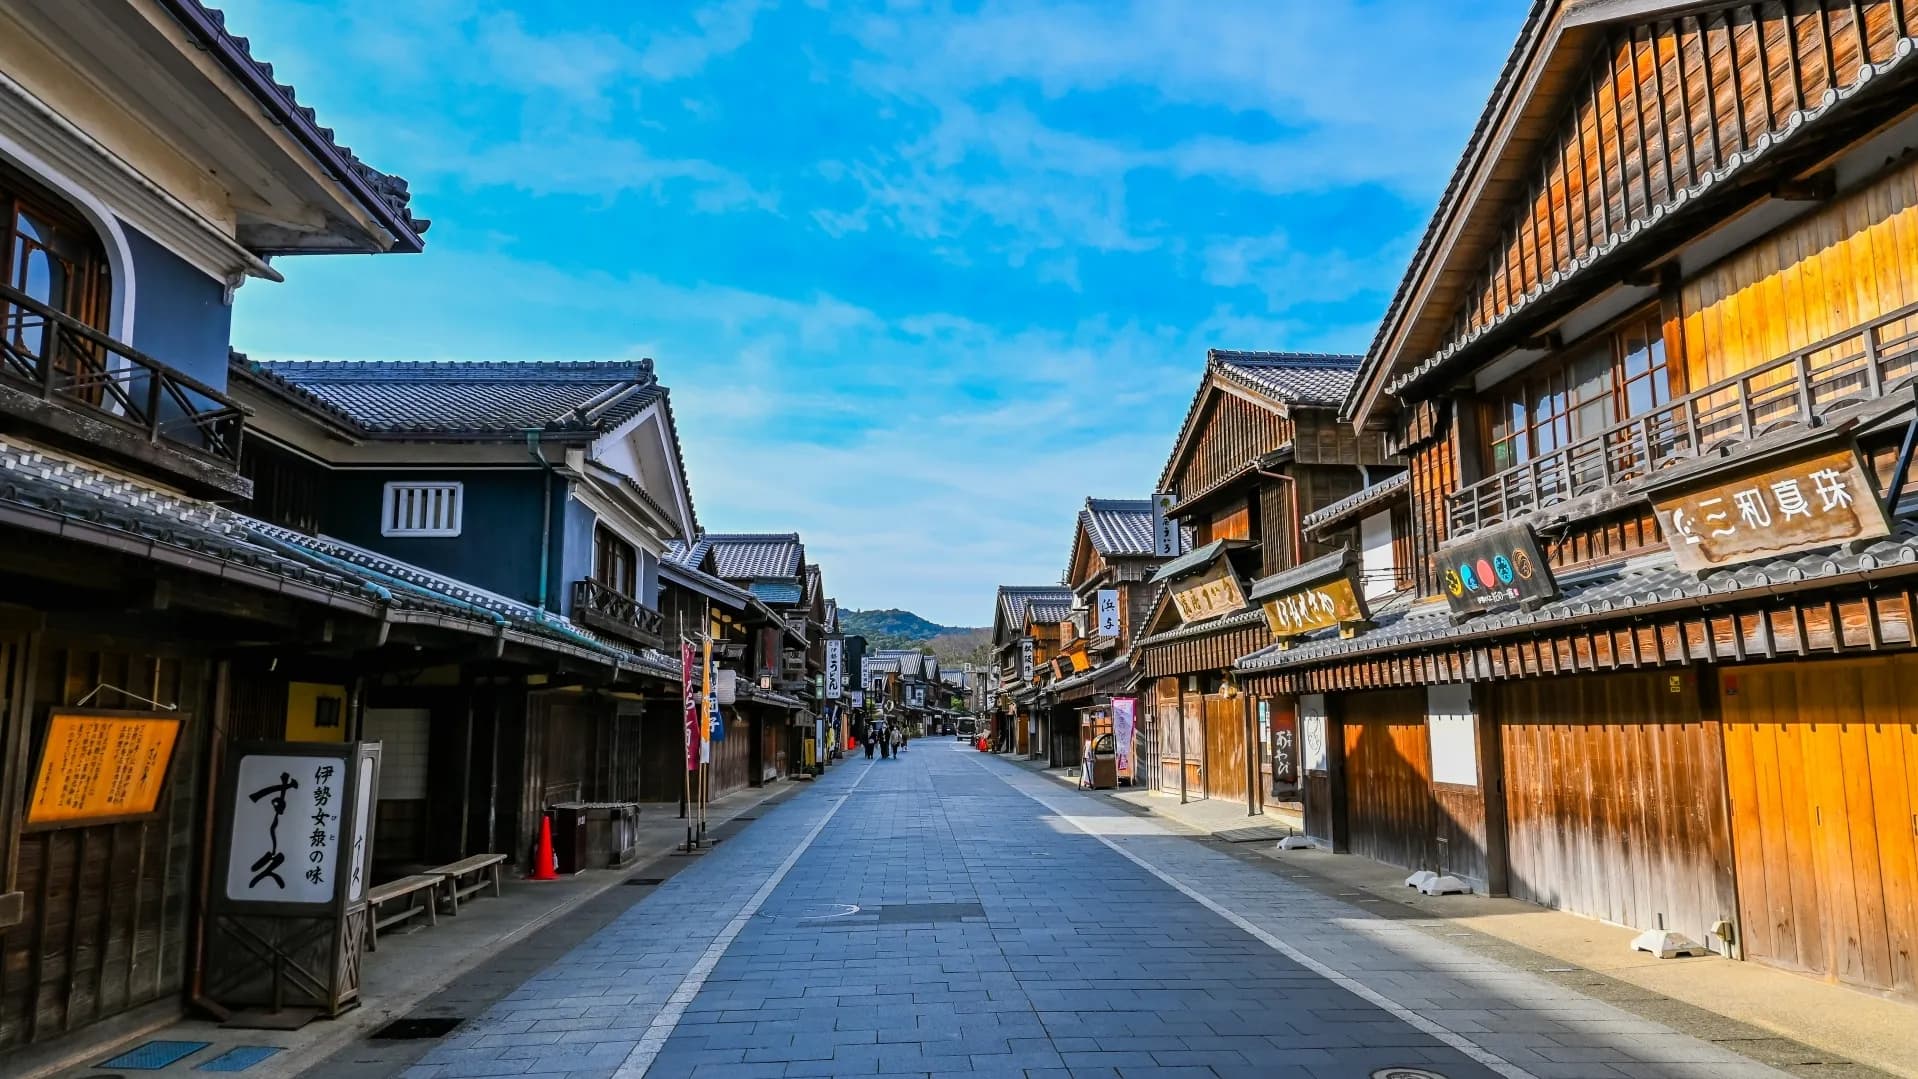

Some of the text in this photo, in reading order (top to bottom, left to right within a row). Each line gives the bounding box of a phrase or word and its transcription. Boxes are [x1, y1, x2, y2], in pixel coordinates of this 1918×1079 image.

[1698, 468, 1853, 538] 三和真珠
[306, 765, 334, 885] 伊勢女衆の味
